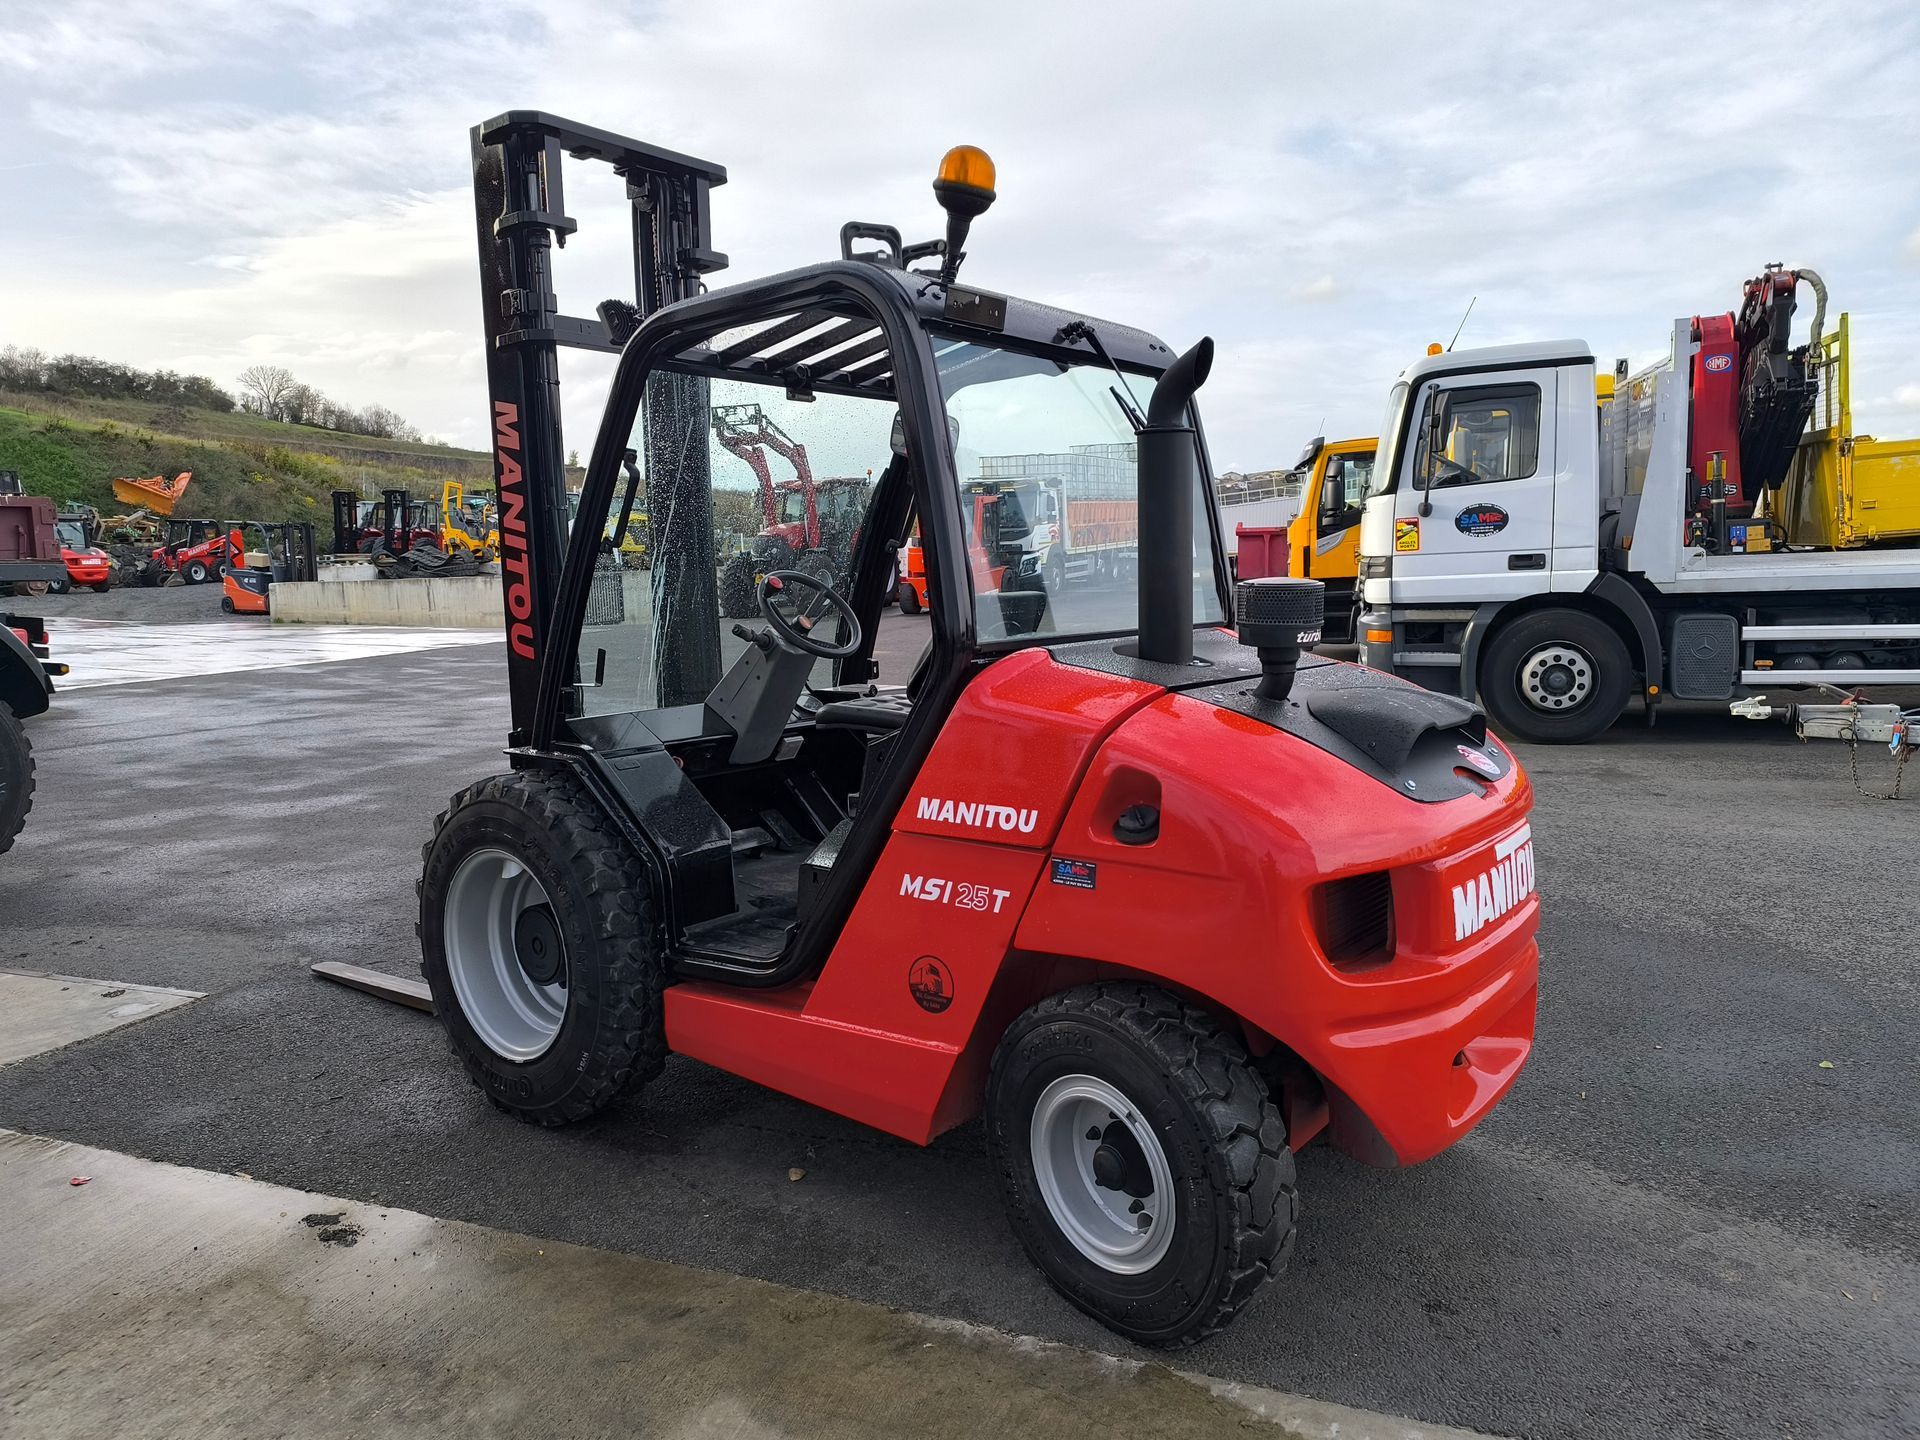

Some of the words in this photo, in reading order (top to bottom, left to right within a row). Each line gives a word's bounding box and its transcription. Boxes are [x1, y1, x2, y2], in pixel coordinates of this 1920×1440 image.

[1709, 357, 1728, 369] HMF
[494, 400, 535, 660] MANITOU
[188, 543, 210, 557] MANITOU
[1297, 629, 1322, 643] turb
[1837, 656, 1847, 665] AR
[917, 797, 1038, 832] MANITOU
[899, 873, 953, 904] MSI
[1452, 823, 1536, 942] MANITOU
